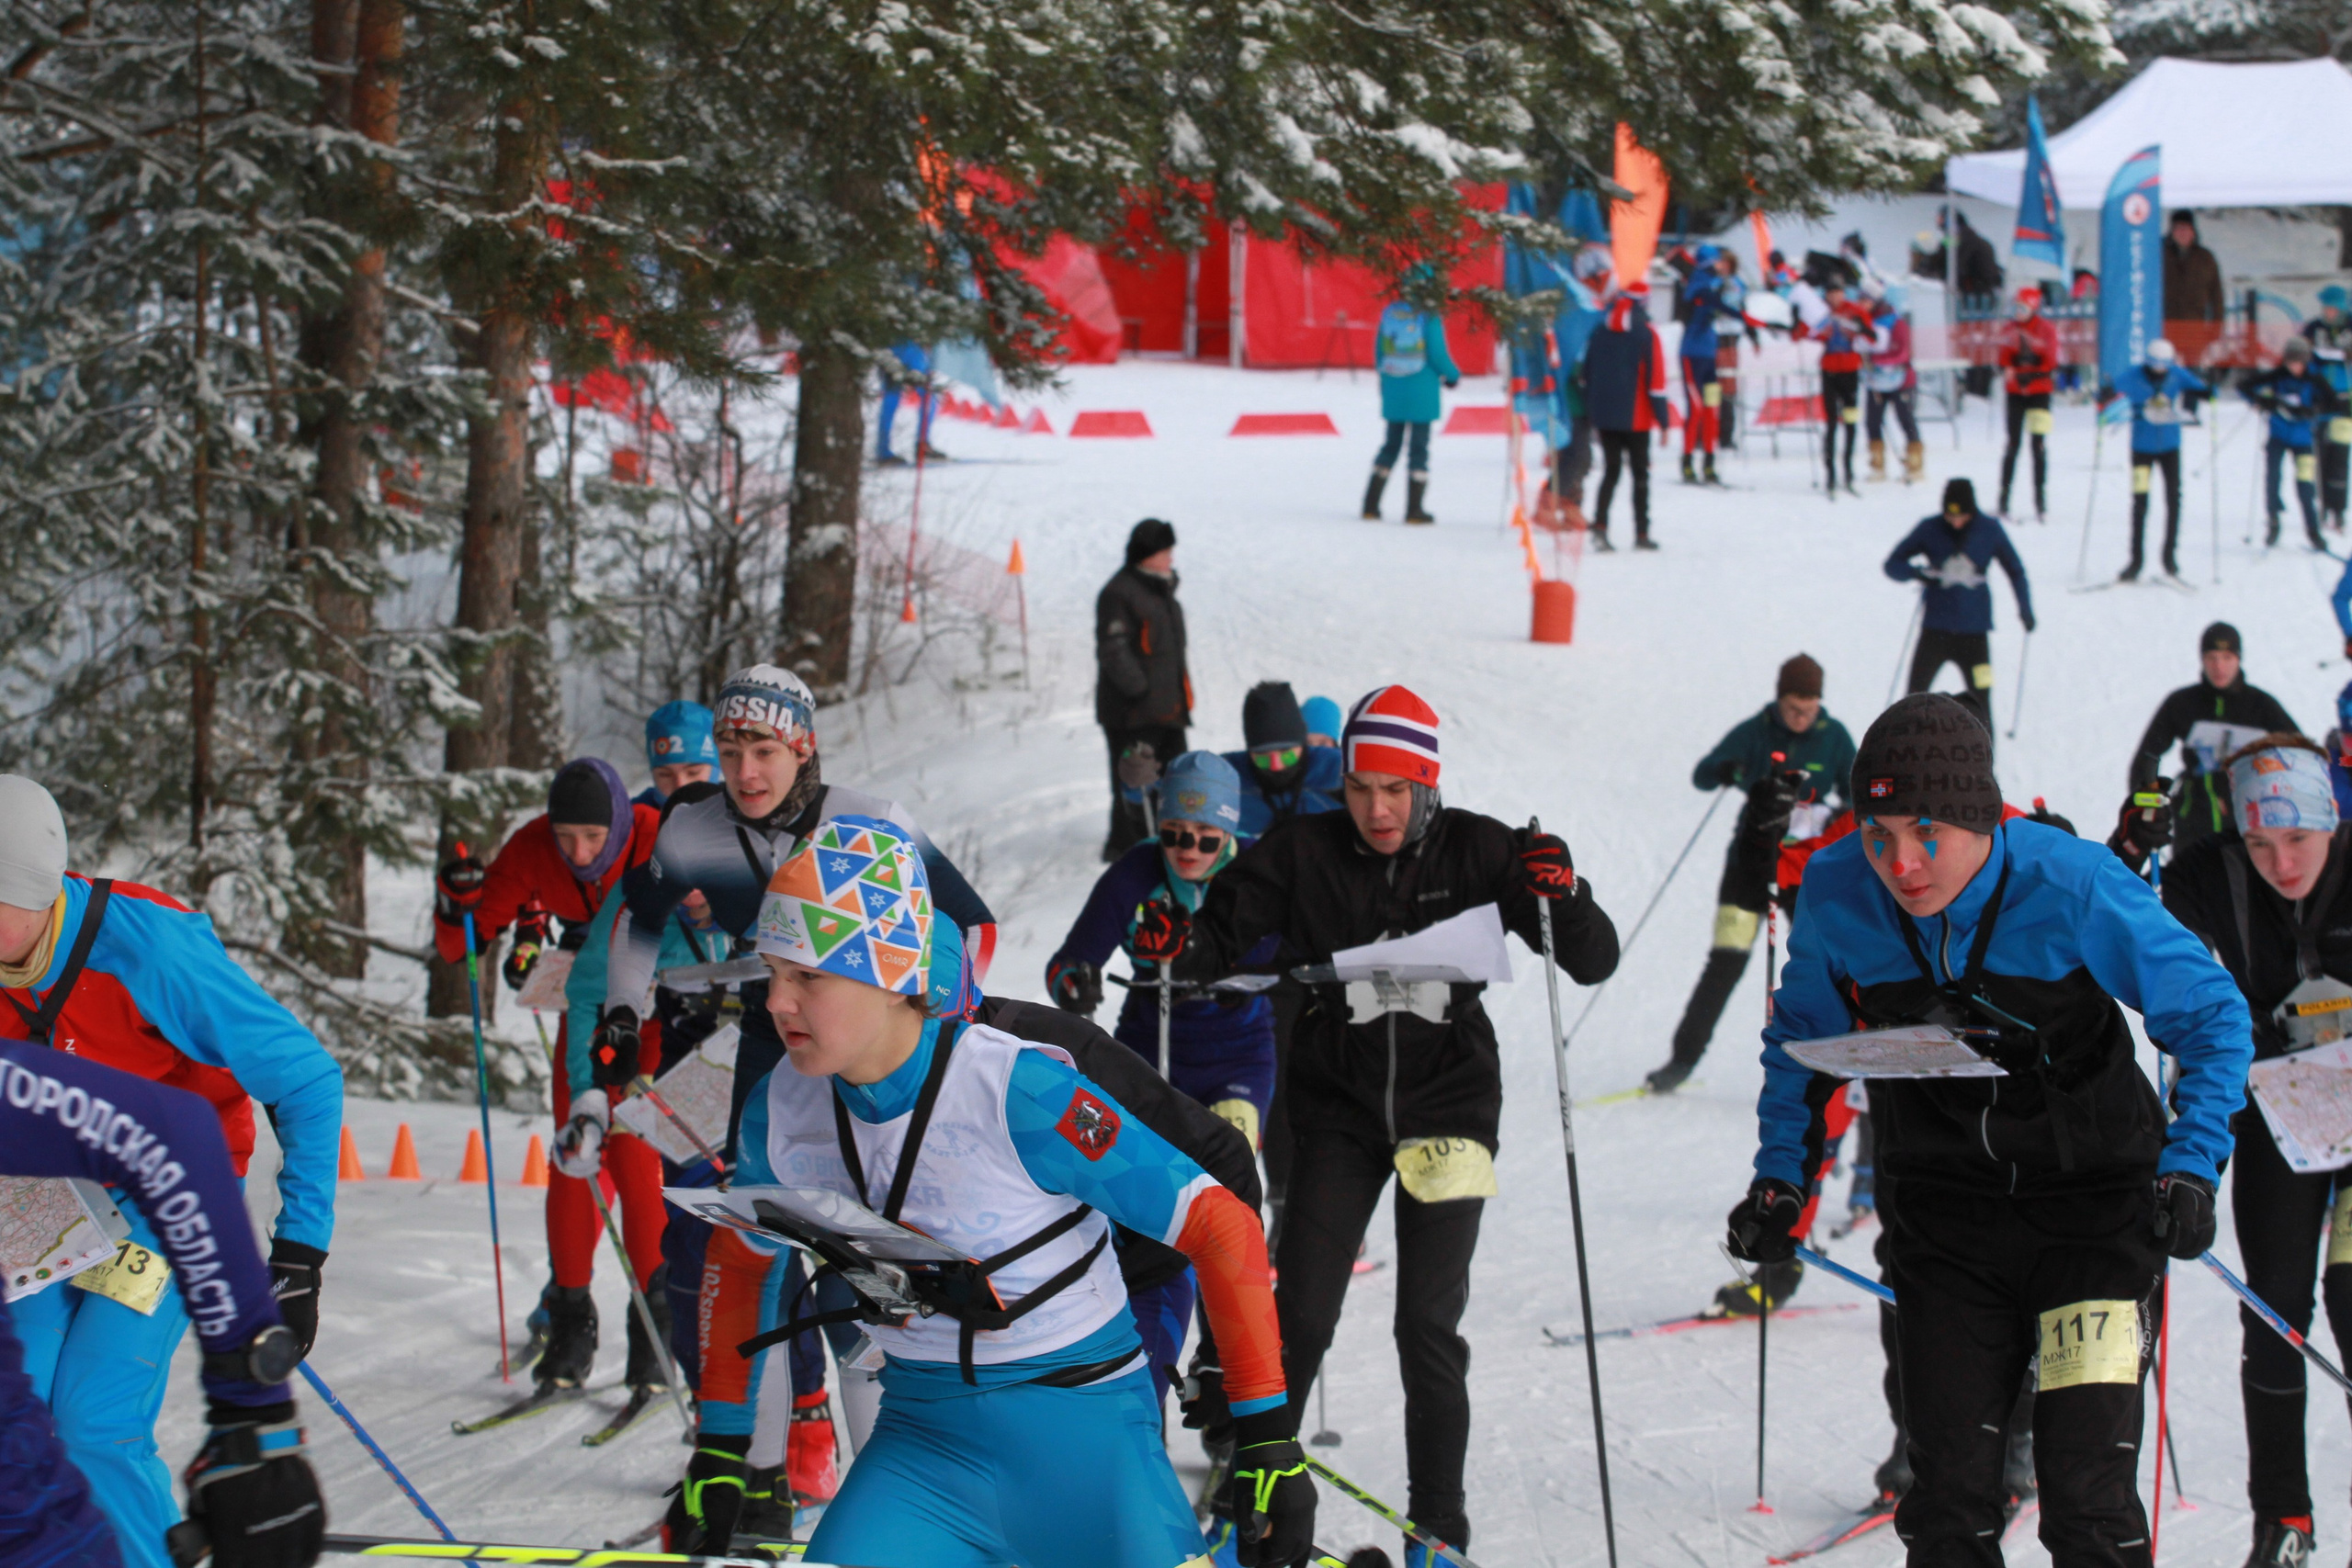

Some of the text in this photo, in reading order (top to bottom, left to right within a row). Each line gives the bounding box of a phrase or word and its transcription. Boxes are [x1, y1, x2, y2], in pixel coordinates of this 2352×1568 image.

[715, 695, 794, 735] USSIA
[155, 1190, 241, 1337] ОБЛАСТЬ
[2052, 1311, 2109, 1348] 117
[2043, 1346, 2081, 1366] МЖ17
